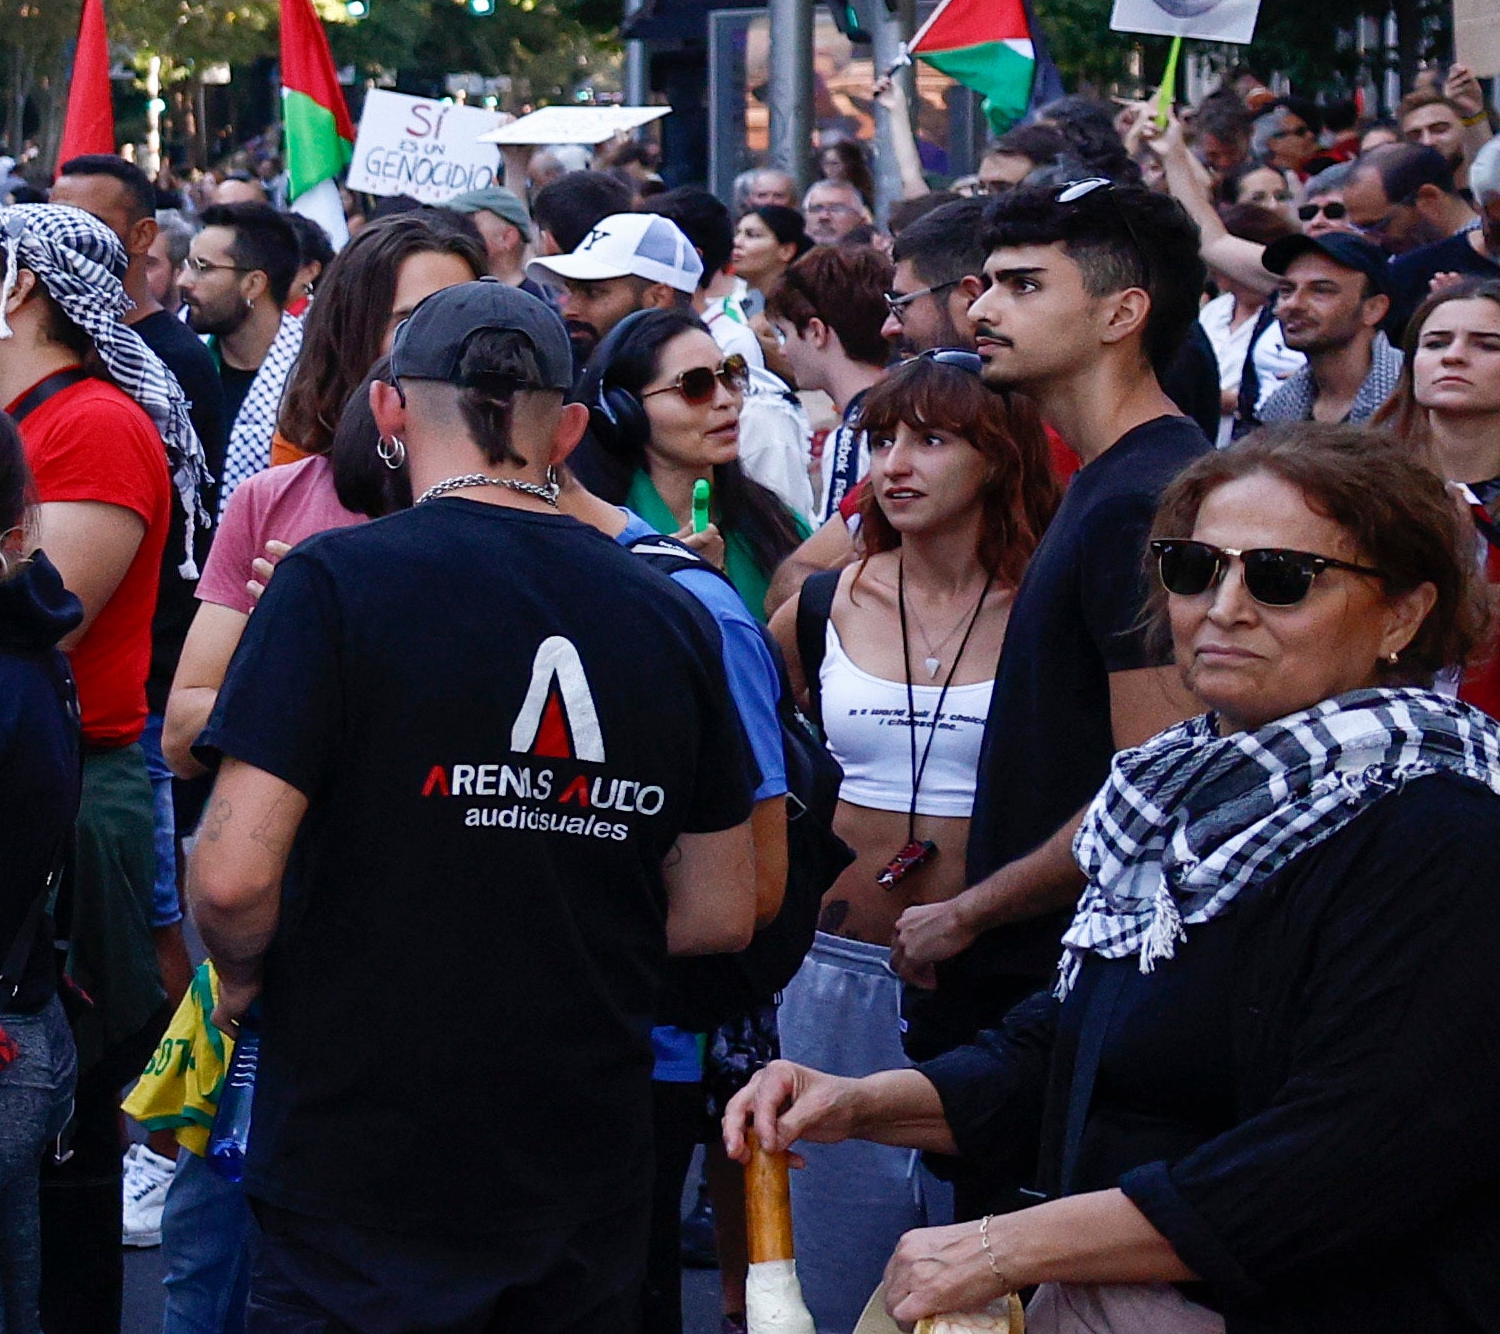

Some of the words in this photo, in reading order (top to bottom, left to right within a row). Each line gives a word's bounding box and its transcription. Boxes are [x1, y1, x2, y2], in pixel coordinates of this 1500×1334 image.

[406, 104, 450, 140] SÍ
[424, 142, 445, 156] UN
[366, 145, 493, 191] GENOCIDIO
